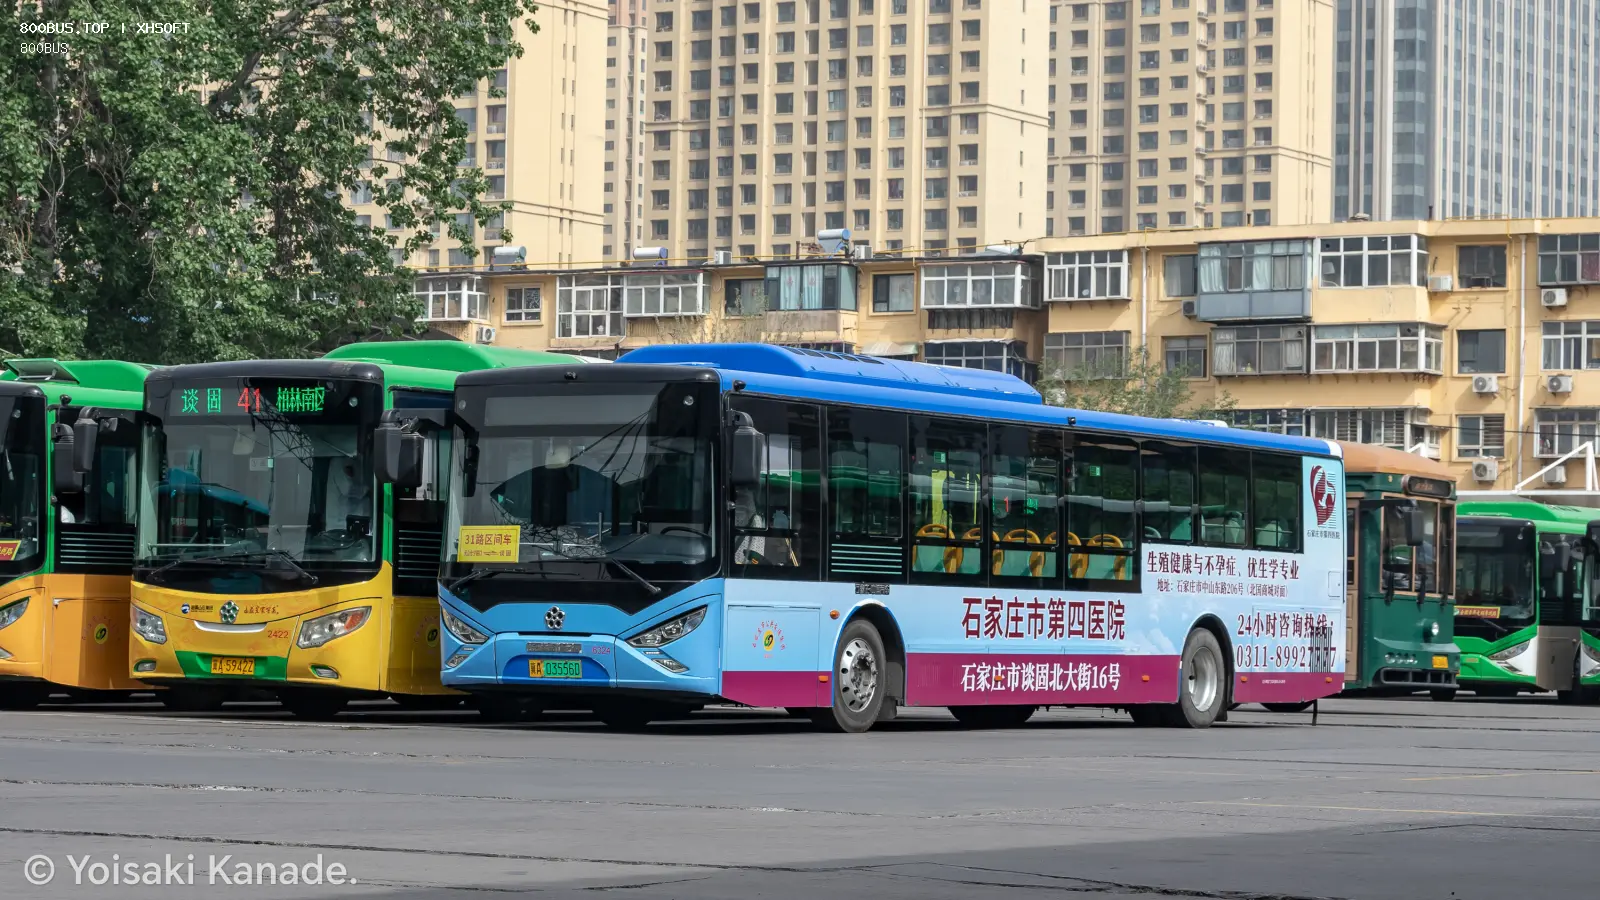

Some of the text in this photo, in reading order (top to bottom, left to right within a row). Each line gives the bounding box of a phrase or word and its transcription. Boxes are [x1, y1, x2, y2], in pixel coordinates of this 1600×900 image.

[181, 387, 325, 413] 谈固 41 柏林南区
[465, 533, 512, 545] 31路区间车
[1147, 550, 1300, 580] 生殖健康与不孕症、优生学专业
[961, 595, 1126, 641] 石家庄市第四医院
[267, 629, 289, 639] 2422
[592, 646, 611, 655] 6324
[961, 662, 1121, 692] 石家庄市谈固北大街16号
